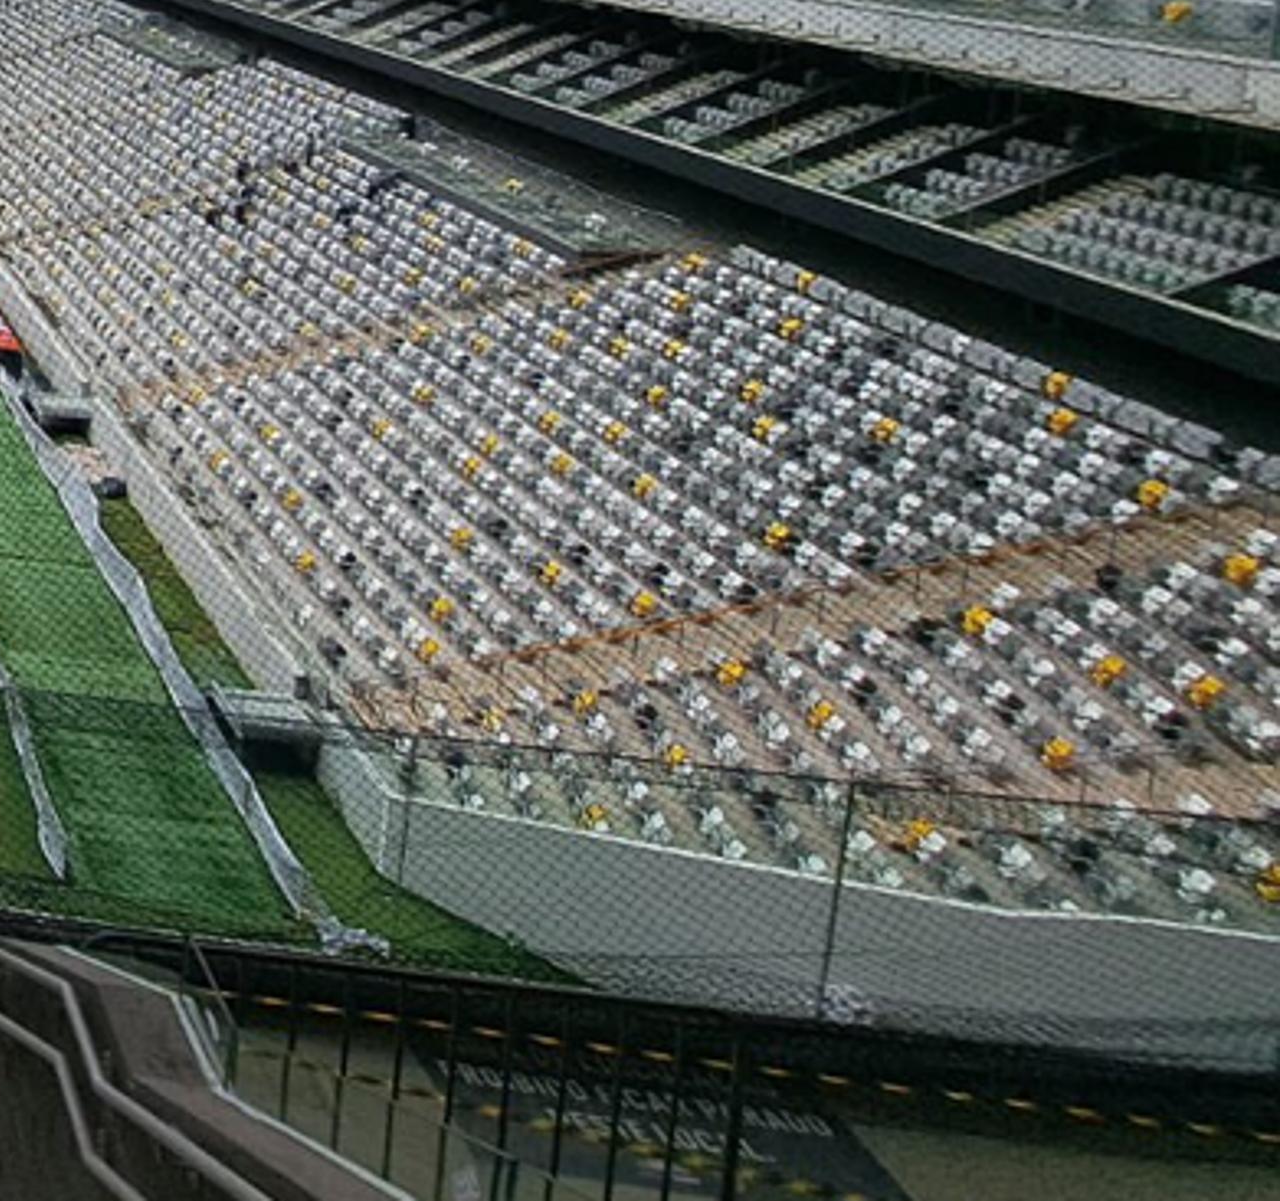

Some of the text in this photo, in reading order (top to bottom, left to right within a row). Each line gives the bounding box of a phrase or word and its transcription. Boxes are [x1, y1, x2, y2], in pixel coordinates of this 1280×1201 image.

[438, 1060, 587, 1100] PROBIDO
[595, 1085, 692, 1117] FCAR
[695, 1099, 834, 1137] PRADO
[651, 1121, 776, 1163] LOCL
